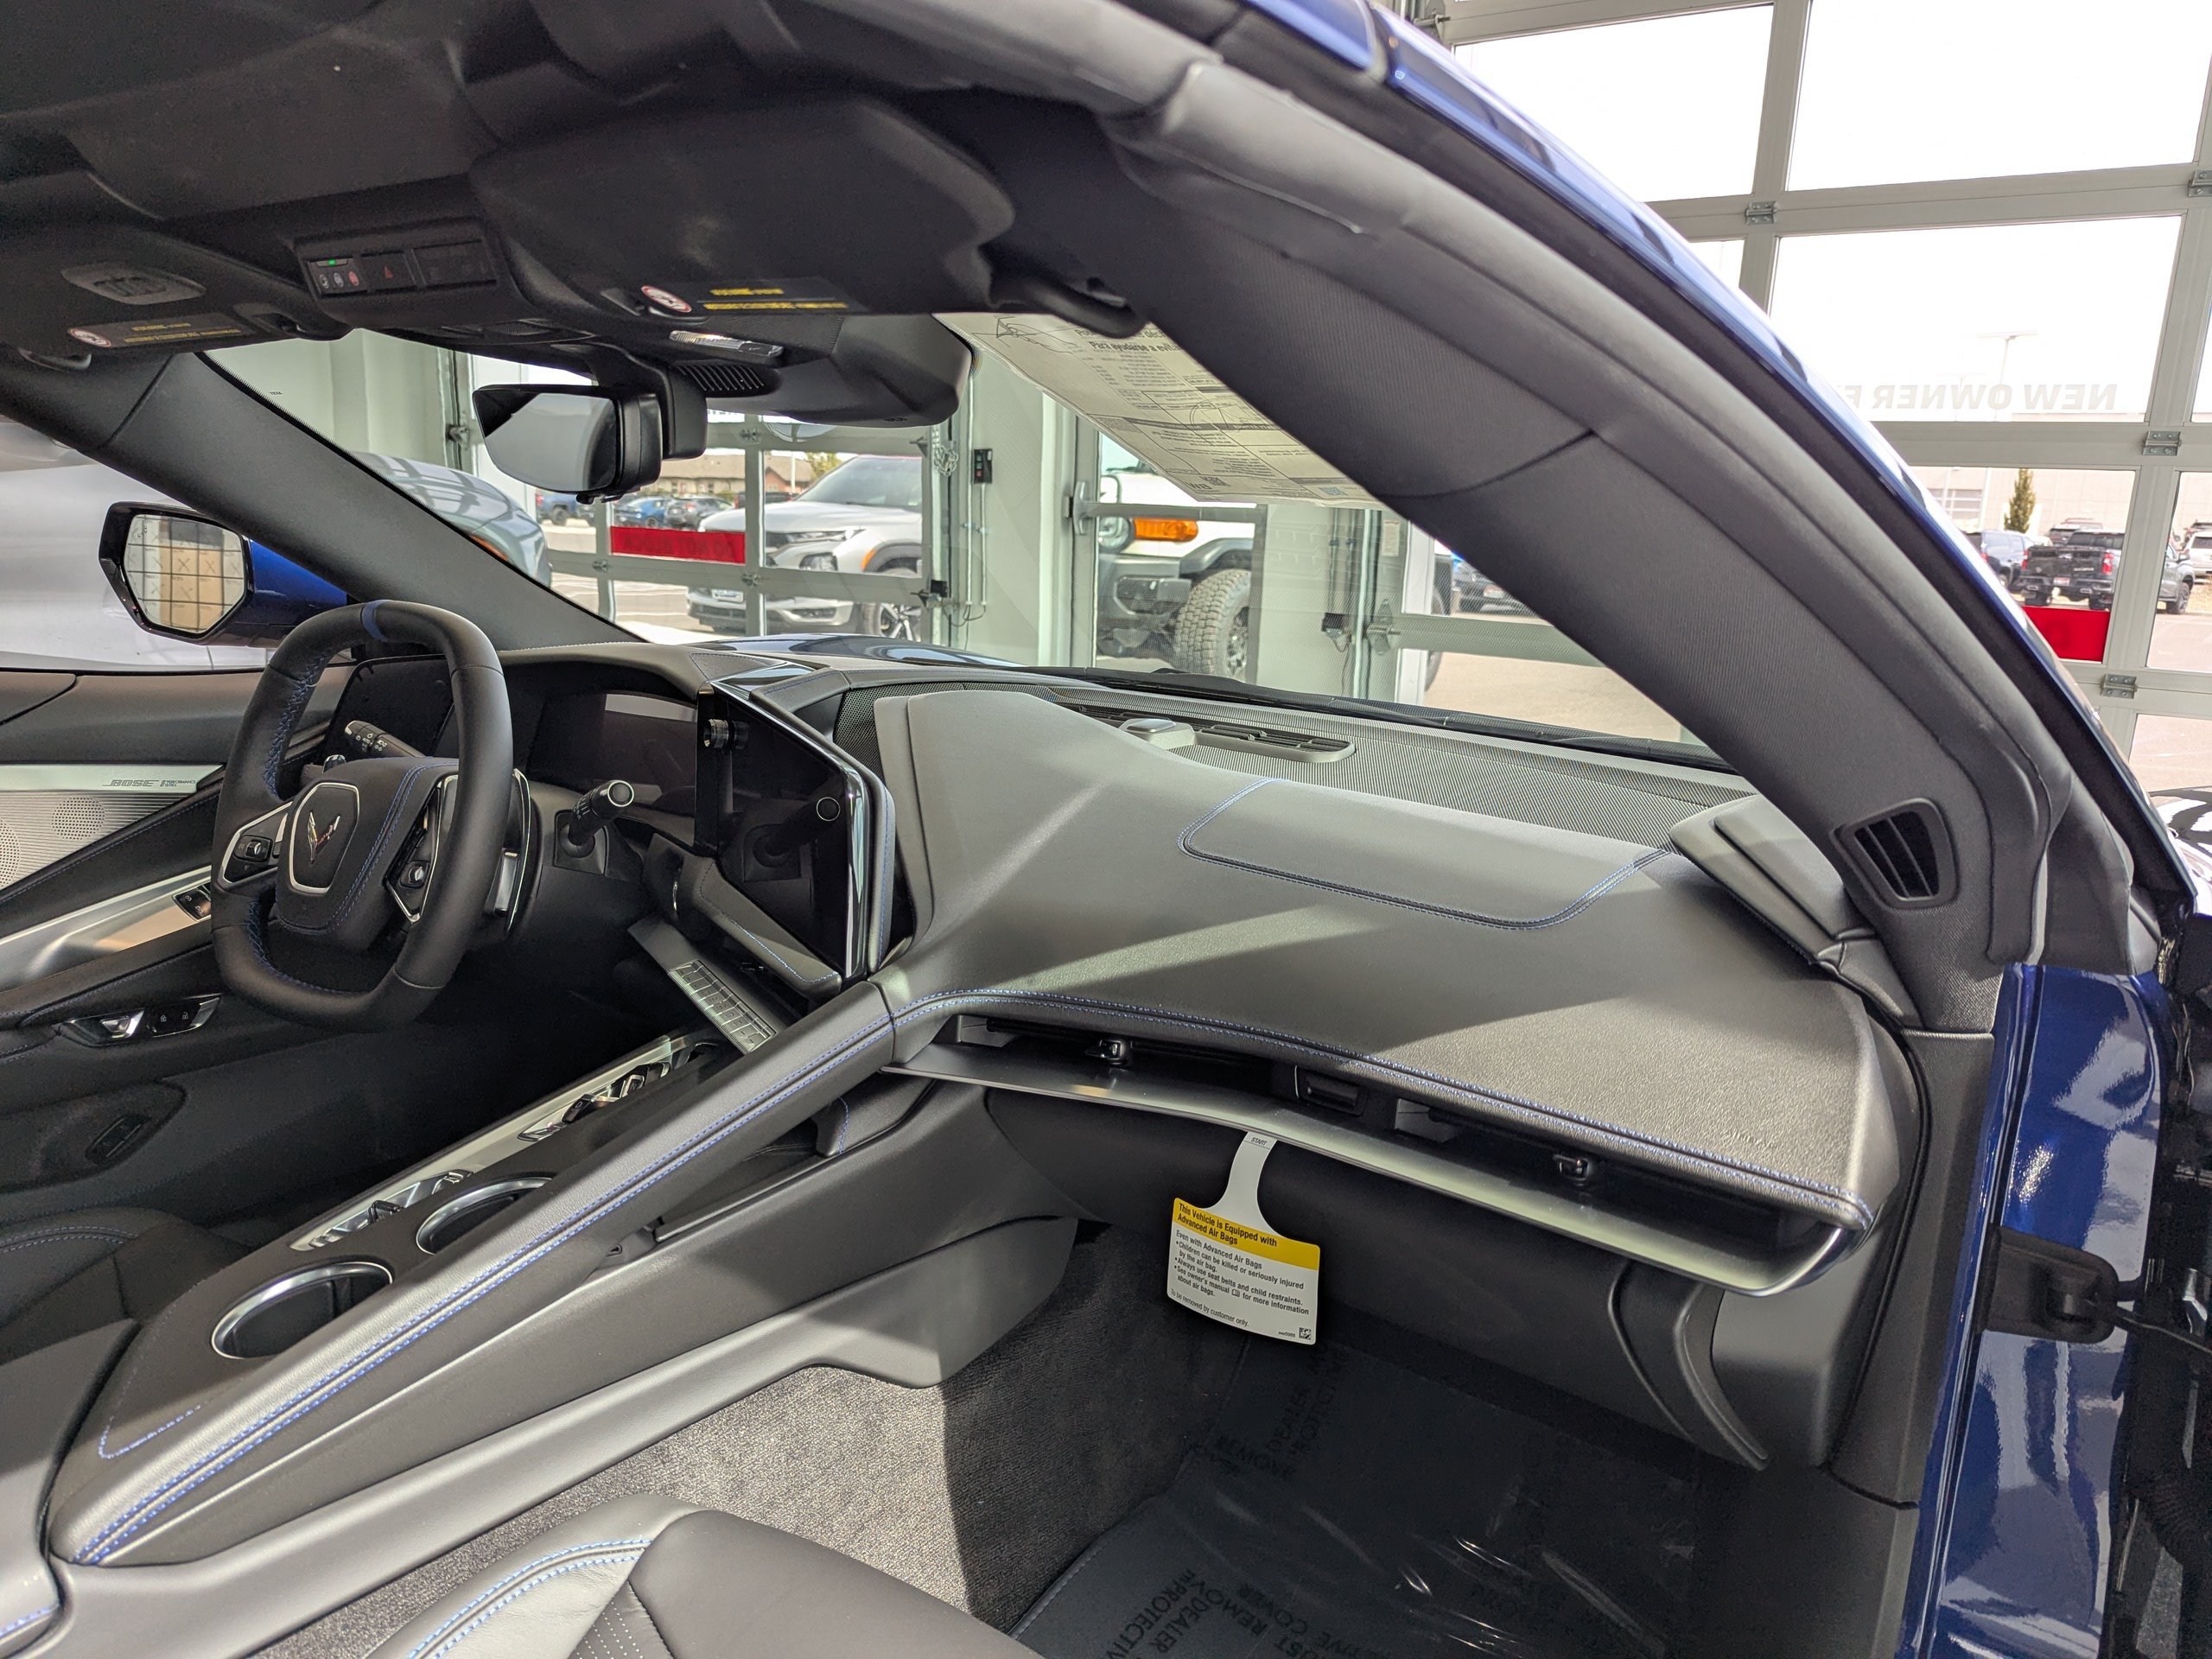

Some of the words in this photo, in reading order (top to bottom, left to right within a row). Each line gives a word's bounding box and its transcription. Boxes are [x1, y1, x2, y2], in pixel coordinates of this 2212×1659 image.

[1250, 1136, 1268, 1146] START
[1178, 1213, 1207, 1233] Advanced
[1209, 1228, 1219, 1237] Air
[1220, 1232, 1238, 1245] Bags
[1179, 1203, 1191, 1216] This
[1192, 1210, 1215, 1226] Vehicle
[1217, 1220, 1223, 1230] is
[1224, 1224, 1258, 1242] Equipped
[1260, 1236, 1277, 1247] with
[1176, 1230, 1189, 1242] Even
[1190, 1237, 1202, 1247] with
[1203, 1243, 1233, 1260] Advanced
[1234, 1254, 1244, 1263] Air
[1245, 1257, 1262, 1269] Bags
[1179, 1249, 1185, 1259] by
[1187, 1254, 1196, 1262] the
[1205, 1262, 1217, 1273] bag.
[1179, 1241, 1200, 1256] Children
[1201, 1252, 1211, 1262] can
[1213, 1256, 1220, 1265] be
[1221, 1260, 1238, 1272] killed
[1248, 1270, 1278, 1285] seriously
[1279, 1277, 1304, 1289] injured
[1177, 1275, 1192, 1287] about
[1200, 1286, 1216, 1297] bags.
[1177, 1265, 1186, 1275] See
[1187, 1270, 1208, 1285] owner's
[1209, 1281, 1230, 1294] manual
[1243, 1292, 1251, 1300] for
[1253, 1297, 1269, 1306] more
[1271, 1300, 1309, 1315] information
[1178, 1257, 1196, 1271] Always
[1208, 1272, 1220, 1282] seat
[1221, 1275, 1236, 1287] belts
[1237, 1283, 1249, 1292] and
[1250, 1287, 1267, 1297] child
[1268, 1292, 1303, 1306] restraints.
[1170, 1287, 1176, 1296] To
[1182, 1296, 1203, 1310] removed
[1204, 1305, 1210, 1313] by
[1211, 1308, 1236, 1322] customer
[1236, 1317, 1249, 1327] only.
[1151, 1596, 1210, 1654] DEALER
